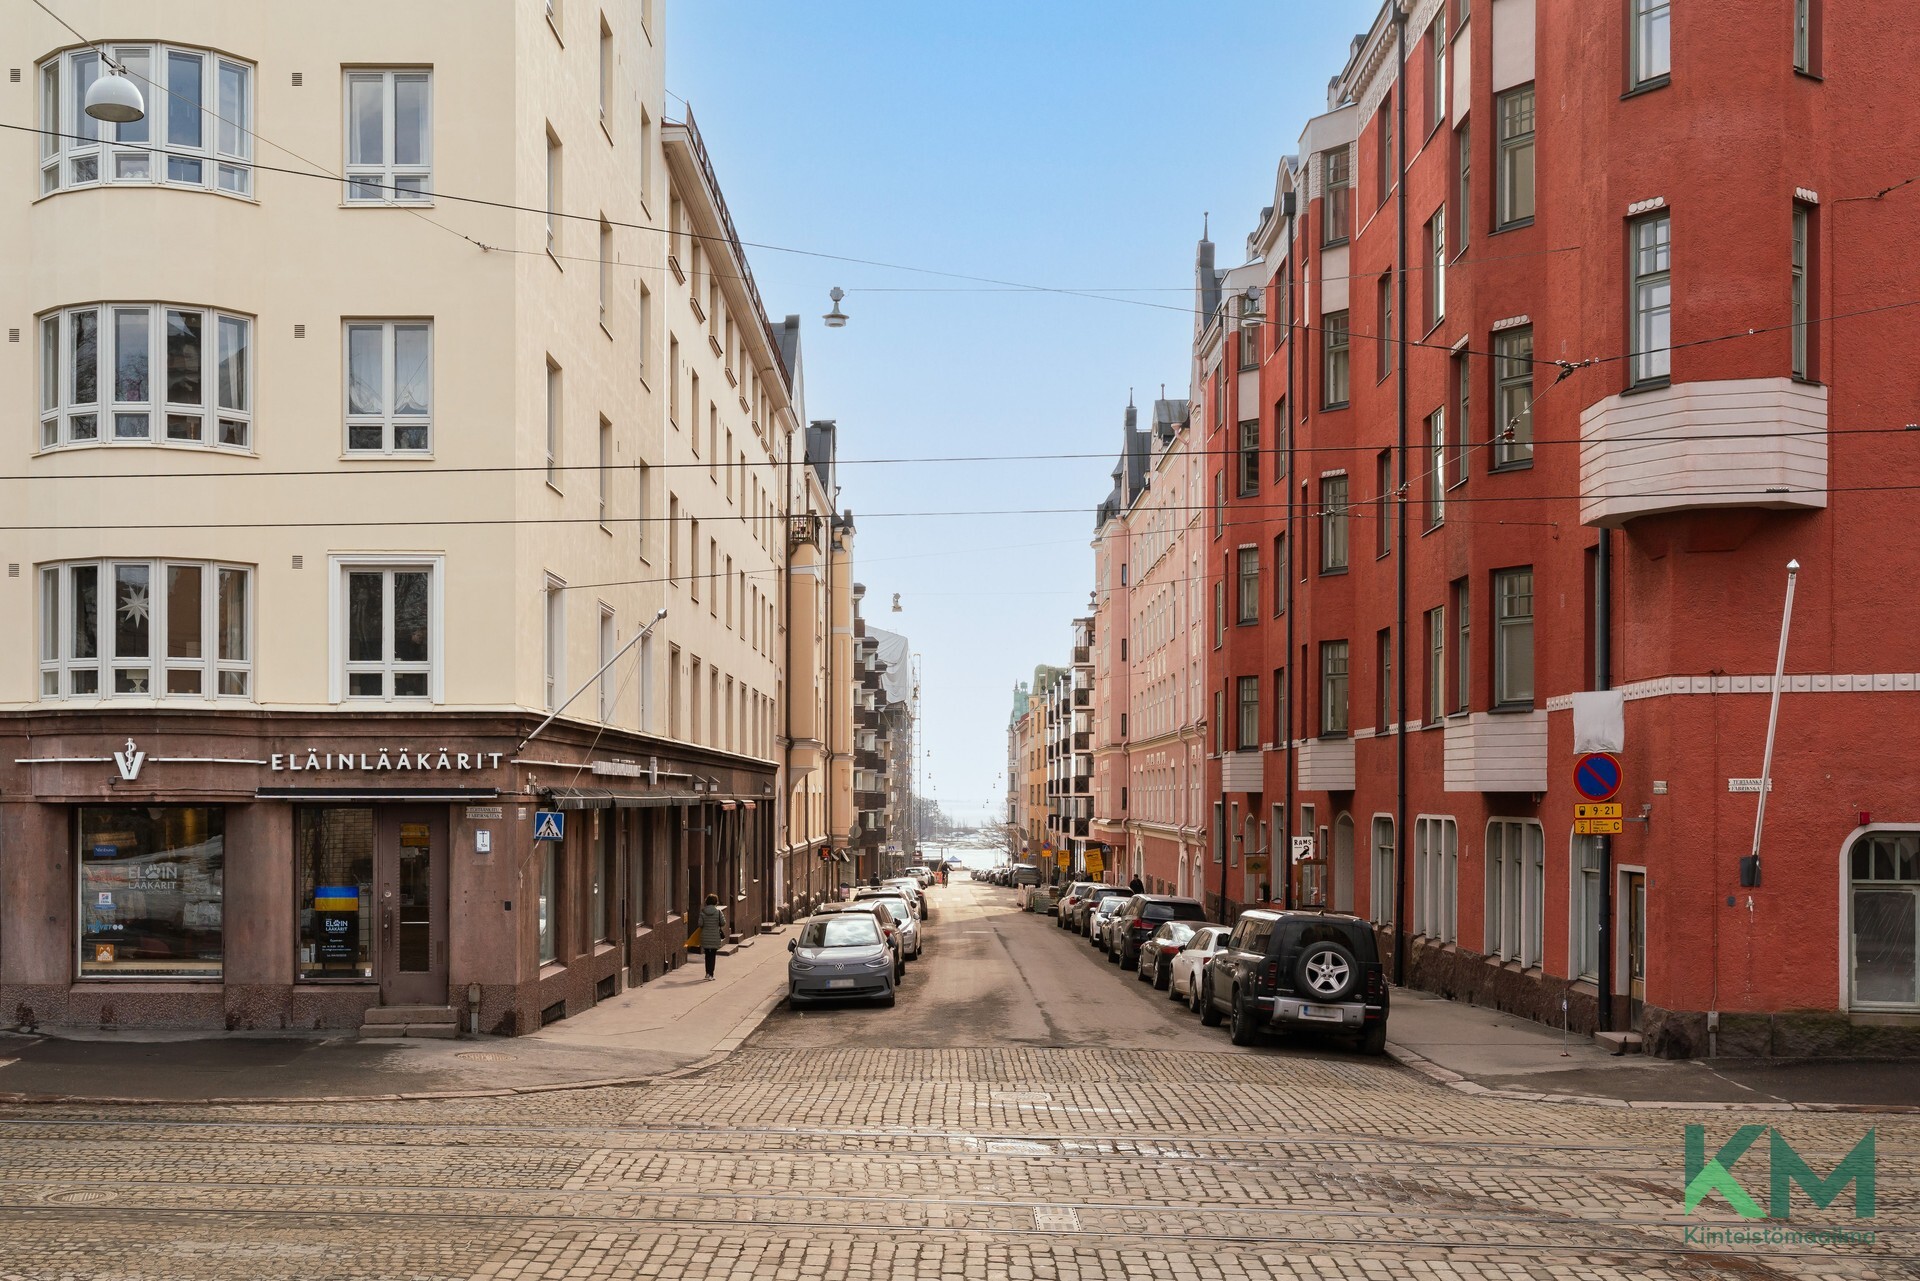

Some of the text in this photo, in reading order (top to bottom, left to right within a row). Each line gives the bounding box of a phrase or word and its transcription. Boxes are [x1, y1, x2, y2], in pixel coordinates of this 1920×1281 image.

[271, 747, 504, 771] ELÄINLÄÄKÄRIT
[1613, 821, 1620, 830] C
[128, 864, 178, 879] ELIN
